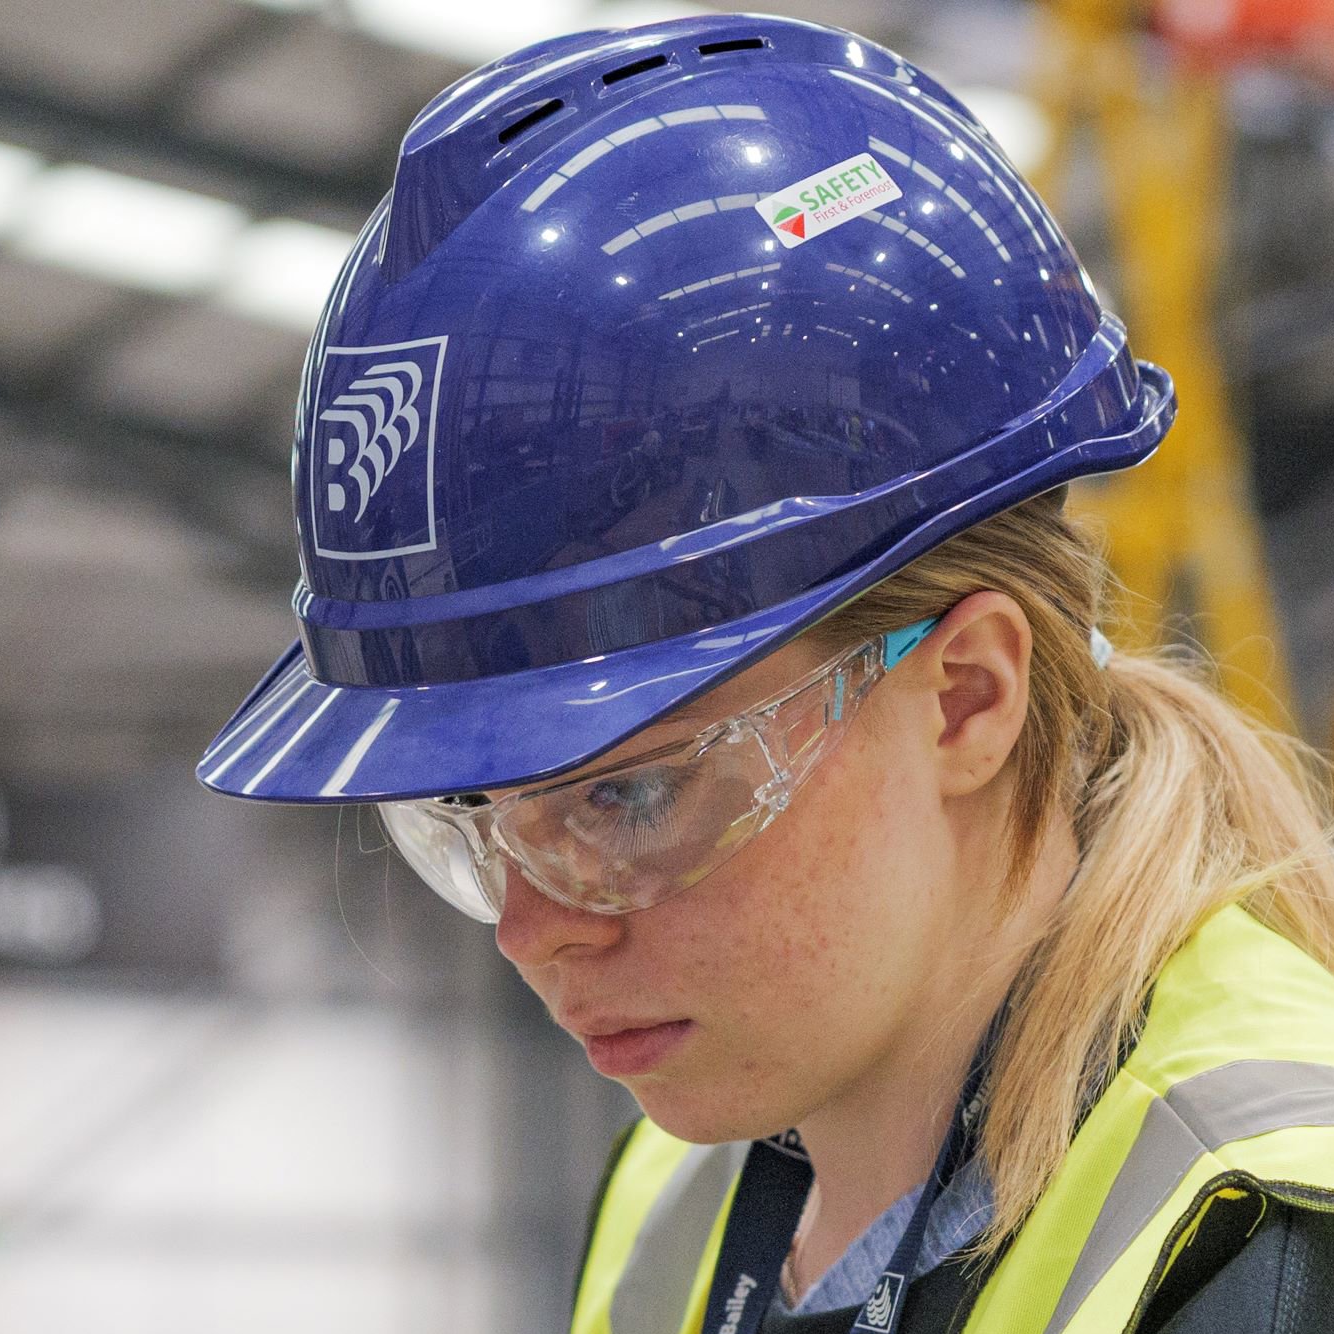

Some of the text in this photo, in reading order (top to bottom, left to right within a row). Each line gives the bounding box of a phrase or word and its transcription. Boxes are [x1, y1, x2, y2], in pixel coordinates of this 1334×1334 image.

[799, 160, 883, 212] SAFETY
[813, 180, 894, 223] First & Foremost
